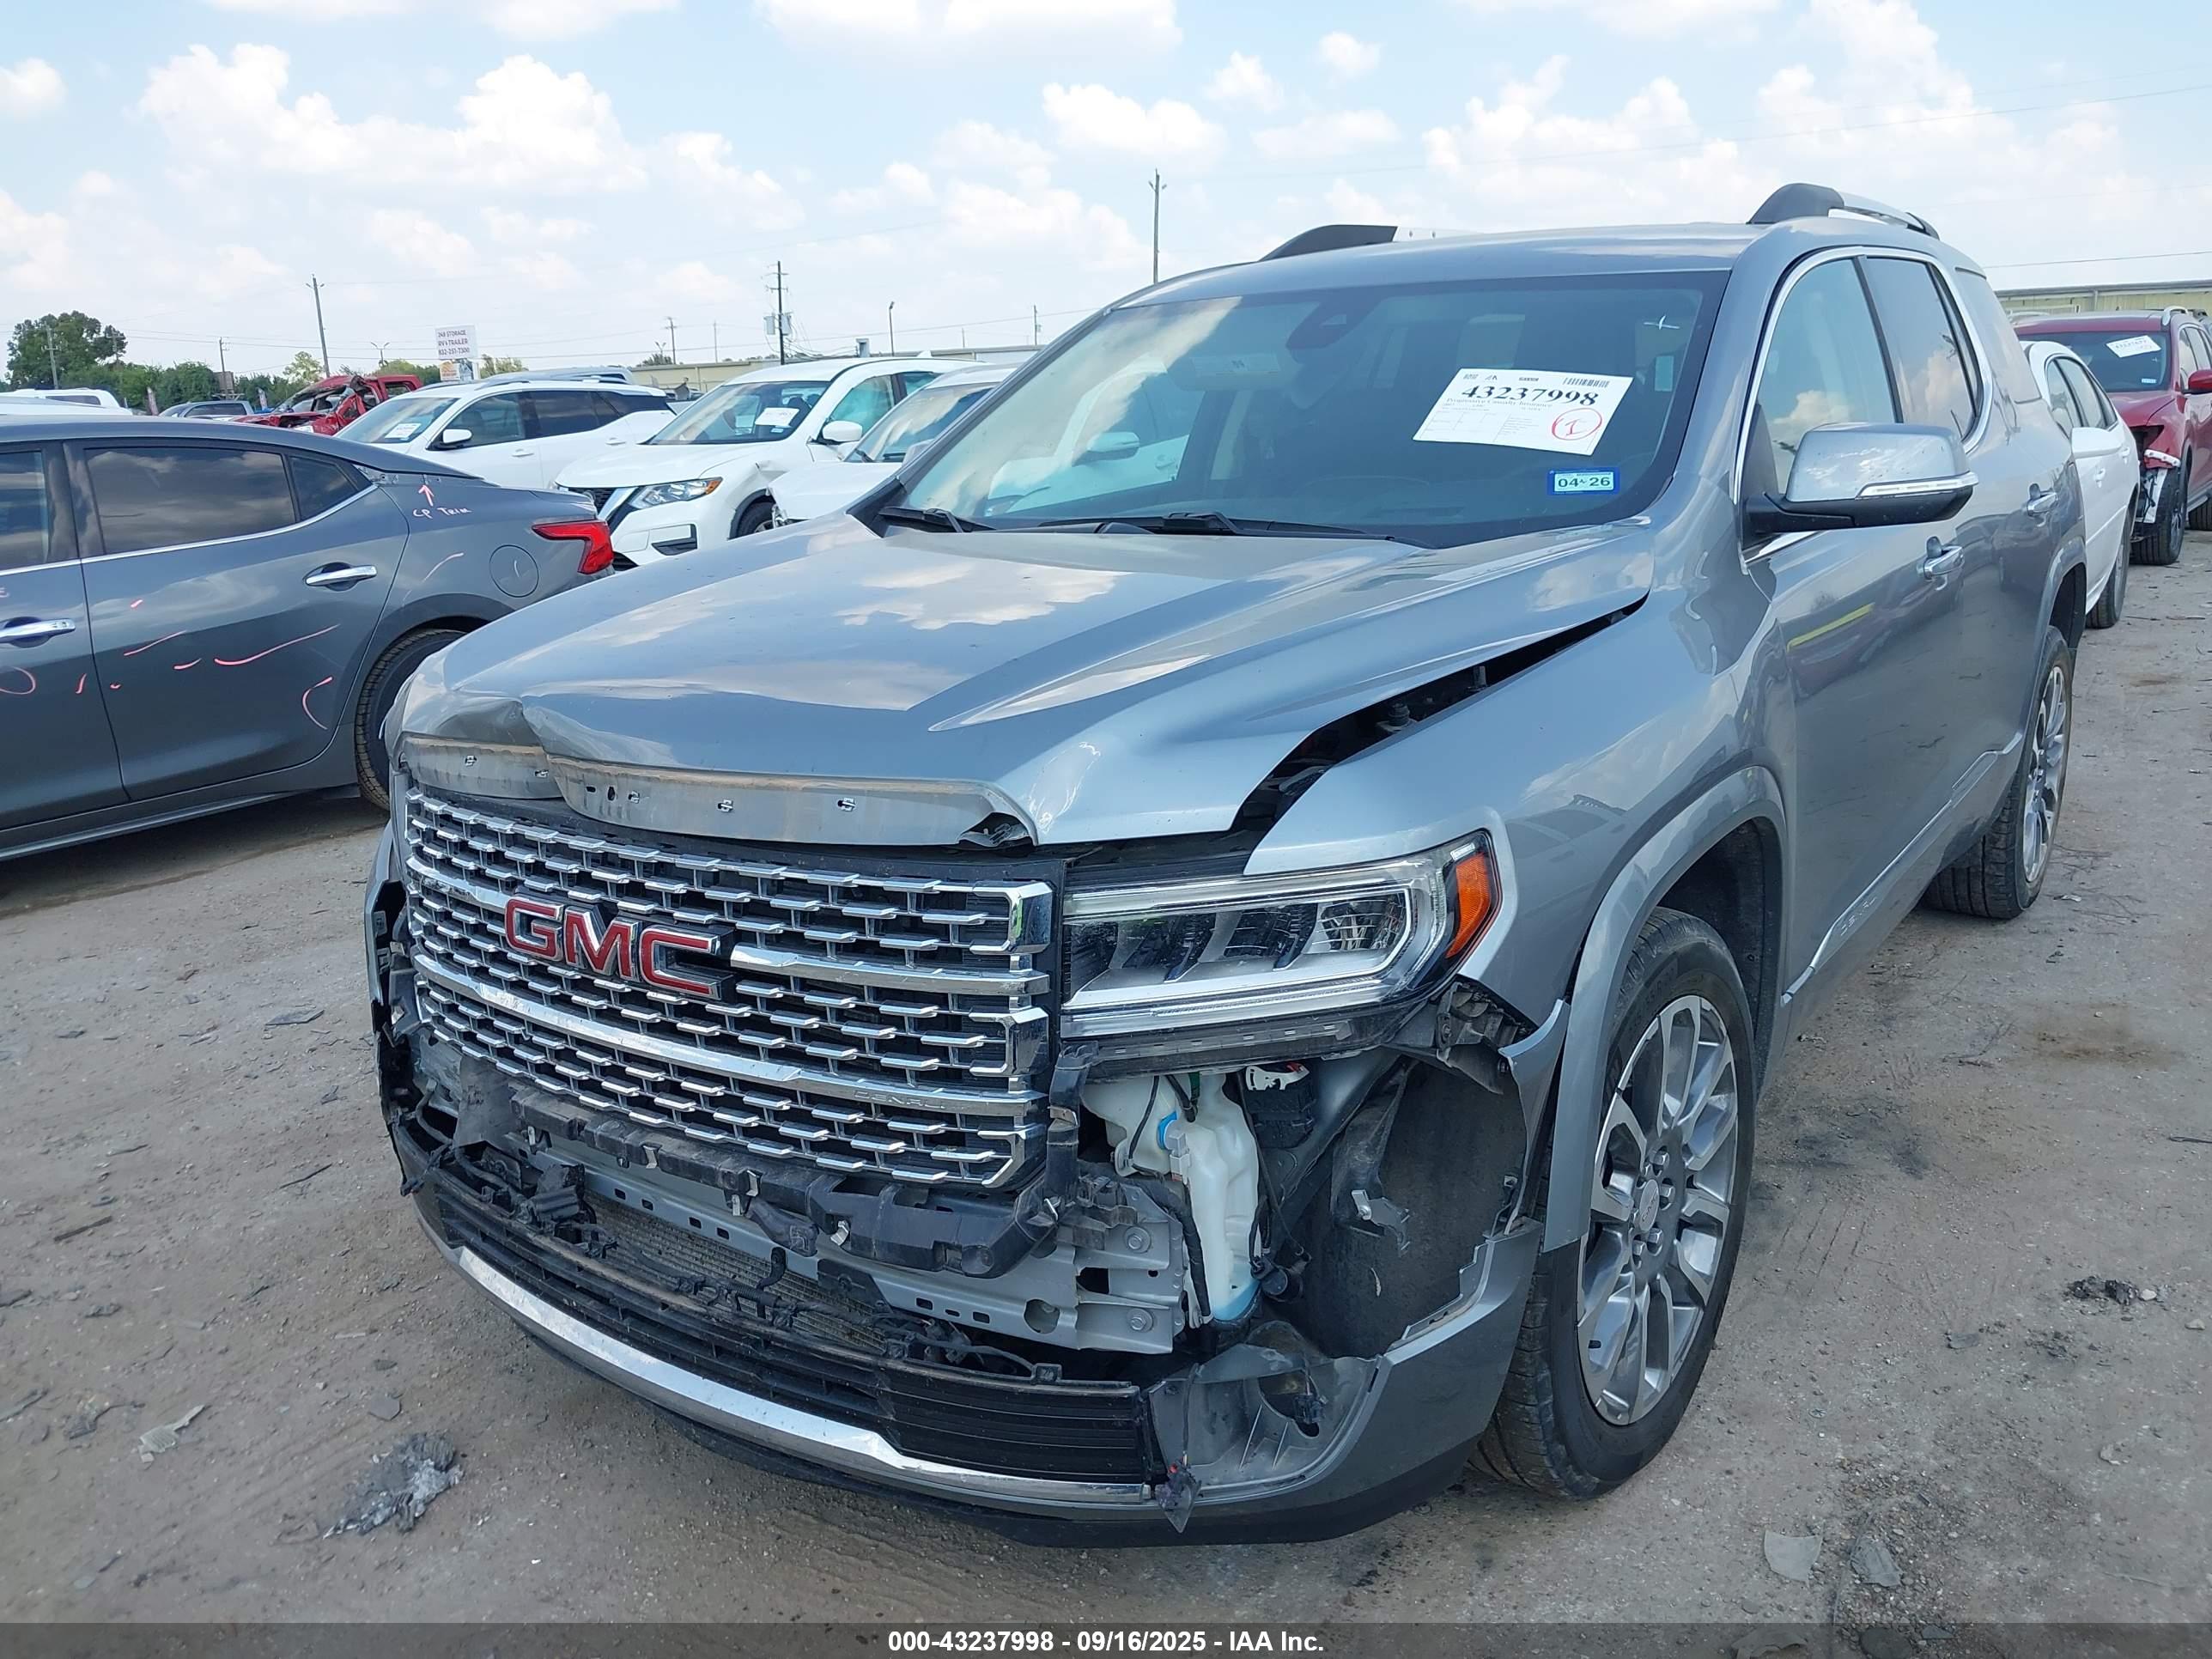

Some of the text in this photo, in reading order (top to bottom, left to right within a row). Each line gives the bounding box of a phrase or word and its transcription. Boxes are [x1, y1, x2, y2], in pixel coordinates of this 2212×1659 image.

[1462, 385, 1599, 406] 43237998
[1558, 477, 1611, 488] 04 26
[504, 896, 723, 1001] GMC
